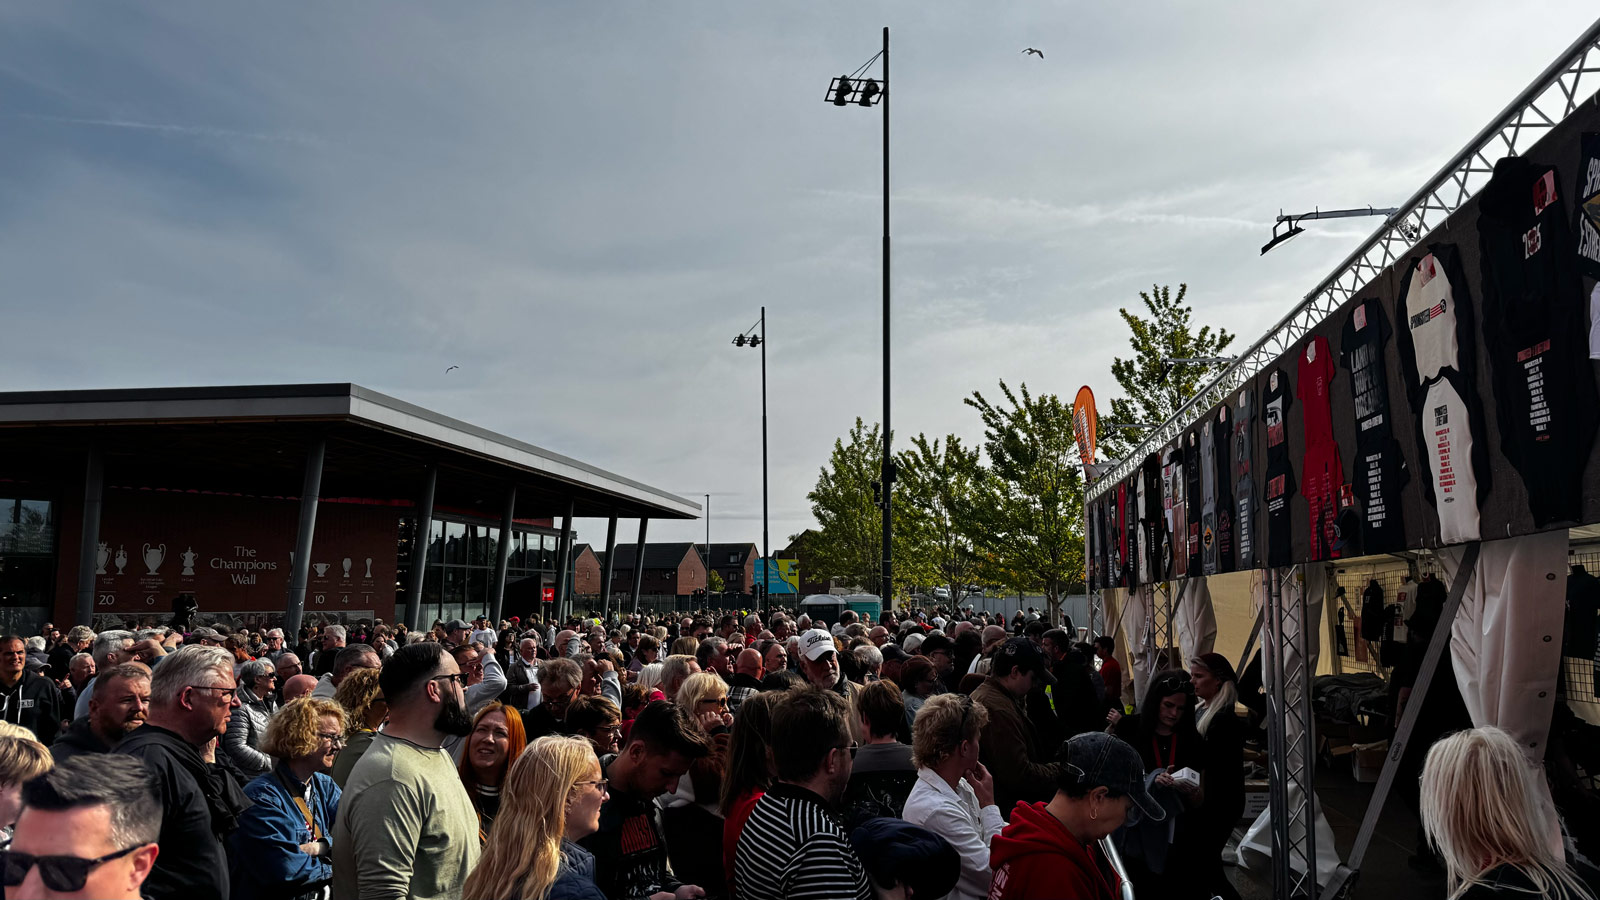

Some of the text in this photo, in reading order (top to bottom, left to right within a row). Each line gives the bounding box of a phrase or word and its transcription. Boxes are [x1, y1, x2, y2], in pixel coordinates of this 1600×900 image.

[1350, 344, 1369, 374] LAND
[1354, 370, 1372, 396] HOPE
[234, 546, 256, 557] The
[210, 557, 277, 572] Champions
[231, 574, 256, 585] Wall
[98, 594, 115, 605] 20
[146, 594, 155, 605] 6
[315, 595, 325, 604] 10
[342, 595, 348, 604] 4
